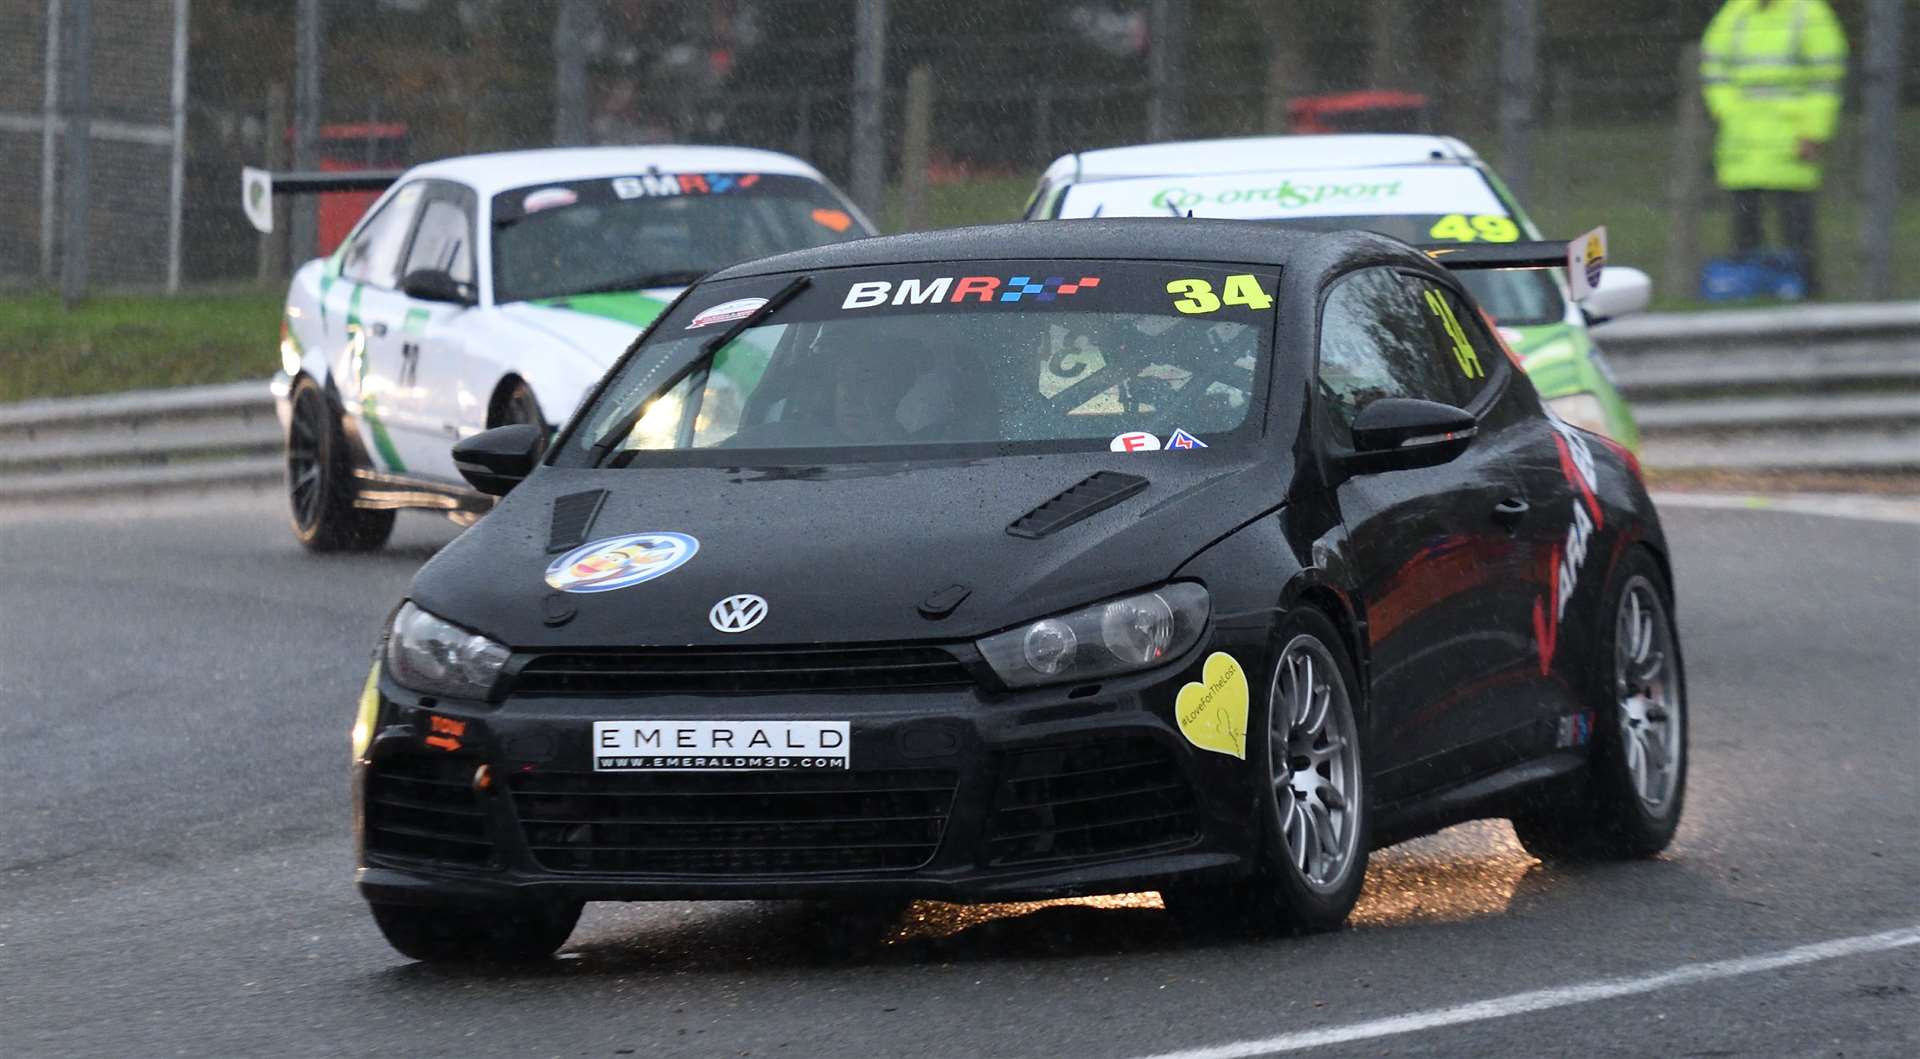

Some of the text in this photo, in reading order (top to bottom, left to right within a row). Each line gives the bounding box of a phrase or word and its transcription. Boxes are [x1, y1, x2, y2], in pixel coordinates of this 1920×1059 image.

[612, 174, 709, 199] BMR
[1429, 213, 1519, 243] 49
[841, 276, 1001, 309] BMR
[1166, 274, 1274, 314] 34
[1424, 289, 1485, 379] 34
[709, 594, 769, 632] VW
[1182, 665, 1237, 728] #LoveForTheLost
[601, 729, 844, 748] EMERALD
